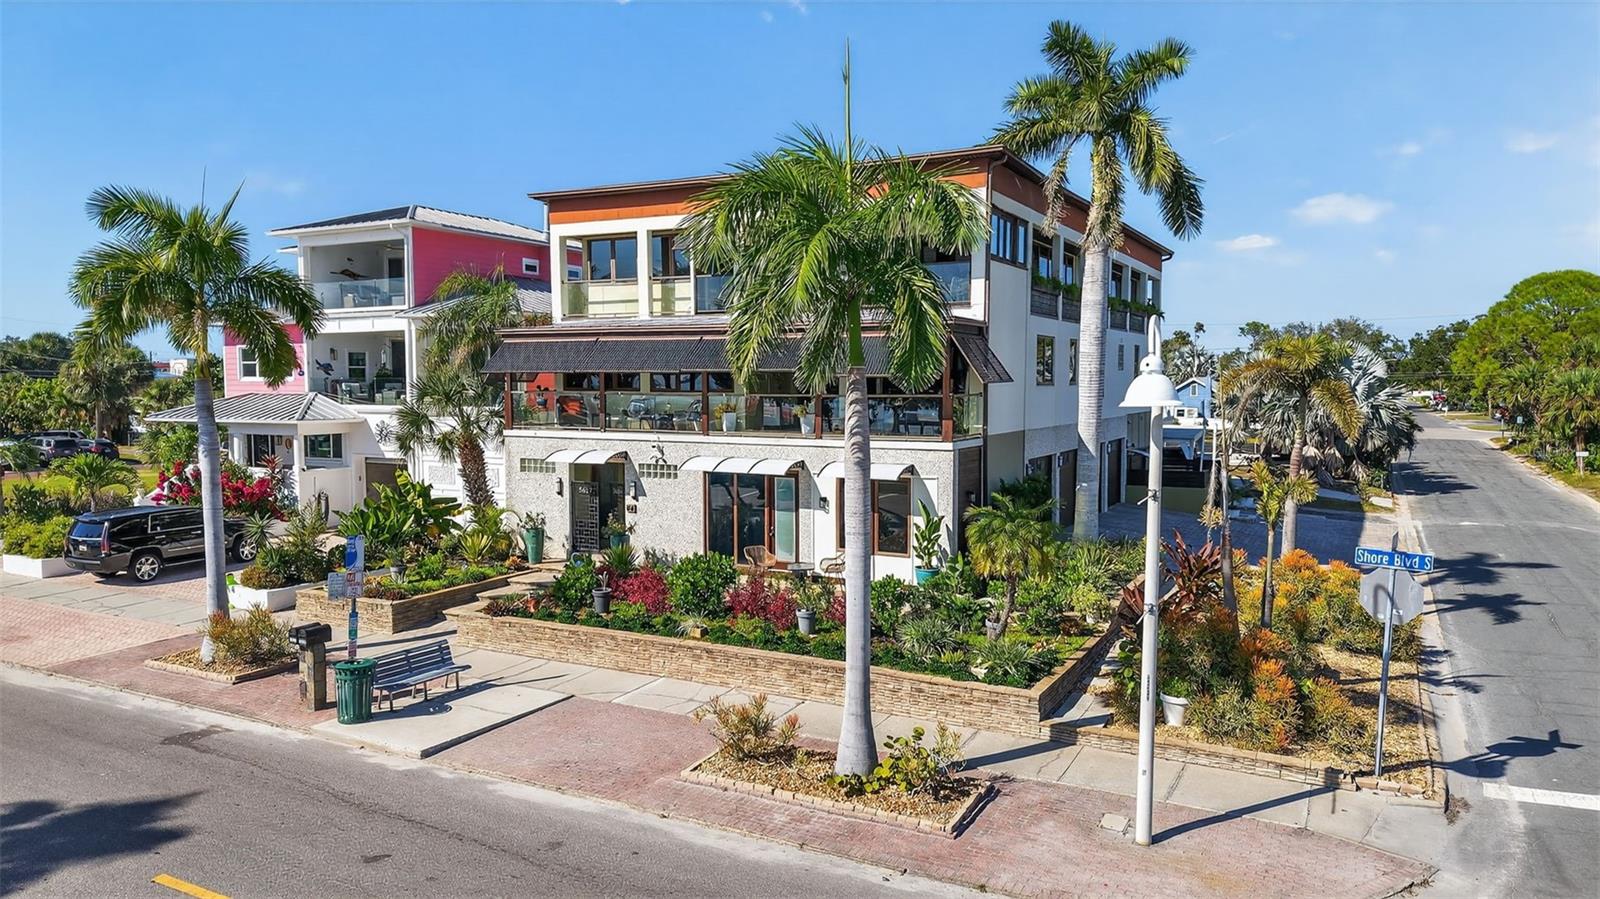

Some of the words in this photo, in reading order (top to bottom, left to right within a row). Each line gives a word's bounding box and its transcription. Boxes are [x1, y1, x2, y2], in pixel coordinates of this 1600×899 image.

[1357, 549, 1389, 565] Shore
[1394, 554, 1419, 569] Blvd
[1424, 556, 1432, 570] S
